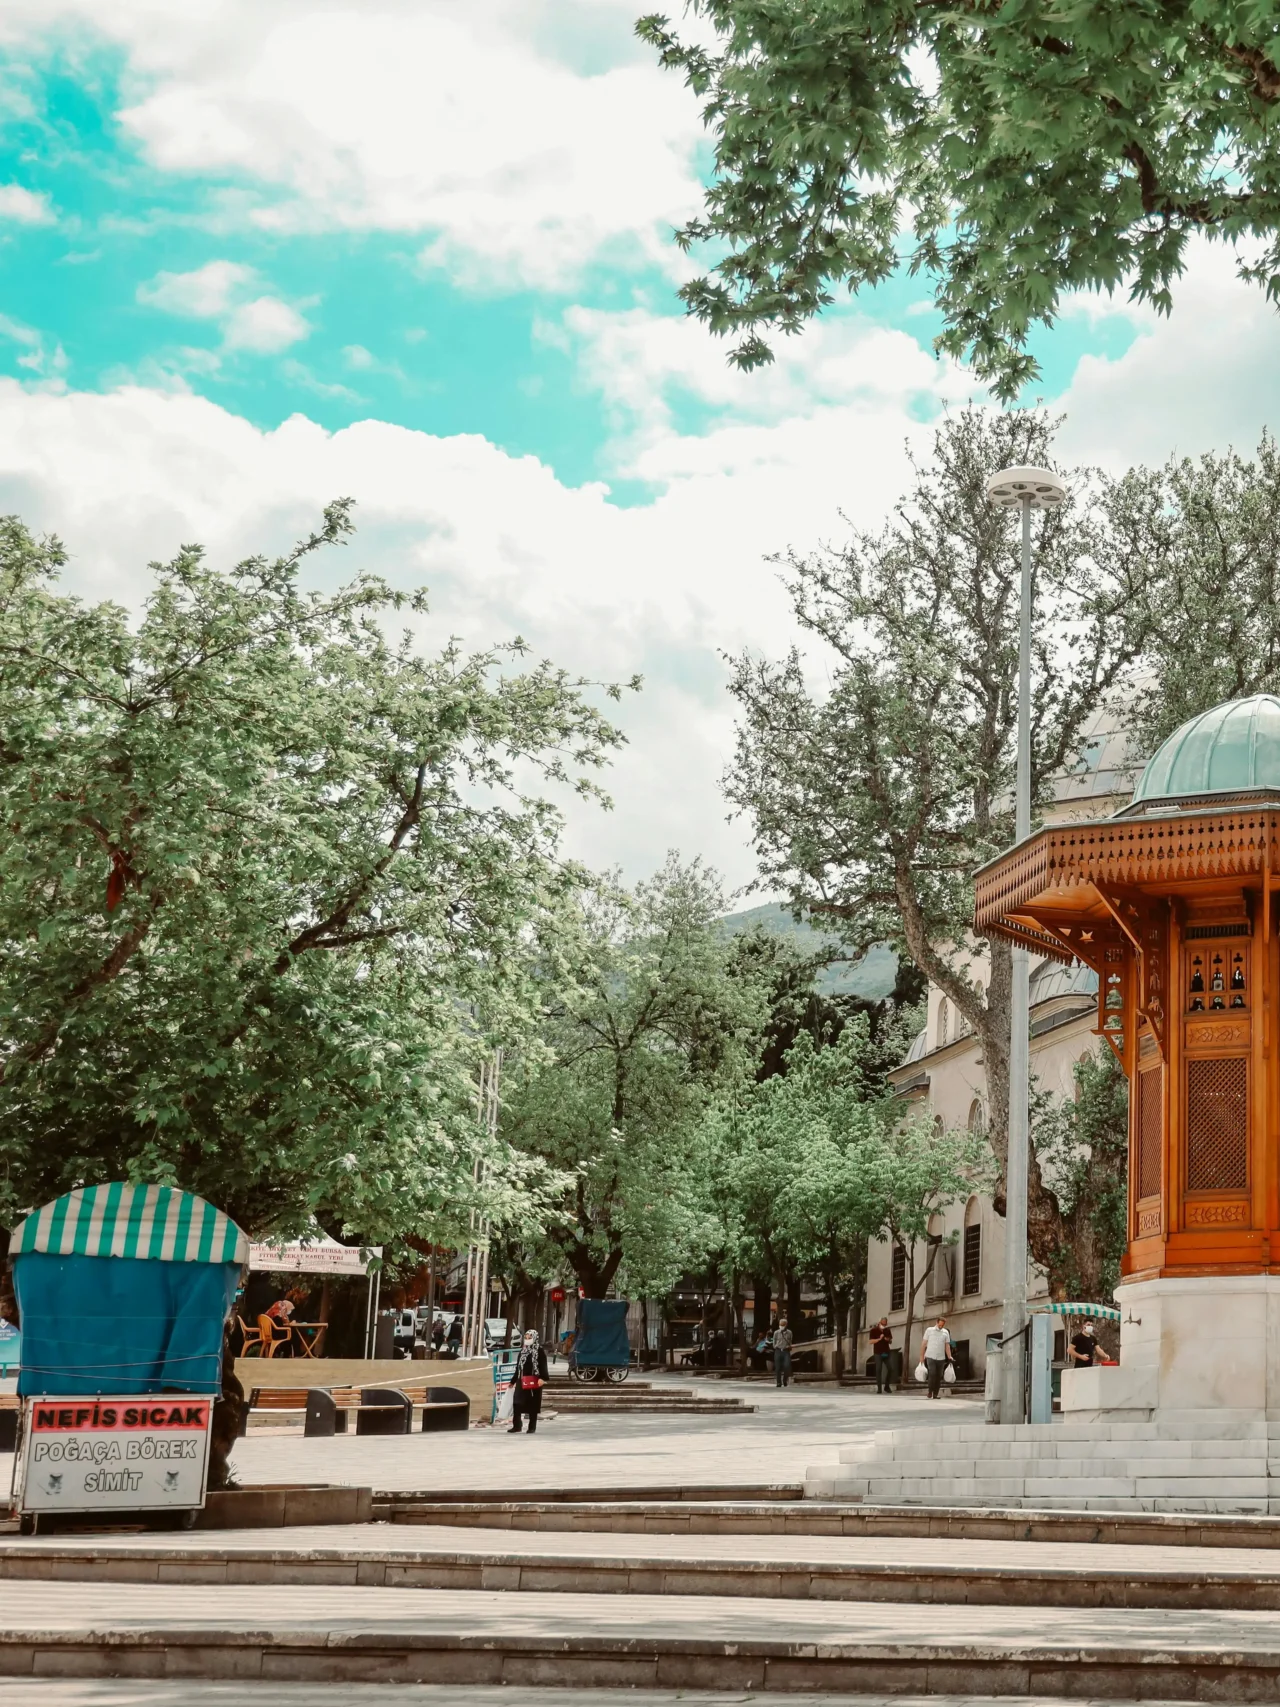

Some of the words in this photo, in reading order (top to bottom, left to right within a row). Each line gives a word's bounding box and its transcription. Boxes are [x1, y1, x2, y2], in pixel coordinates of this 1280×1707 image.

[37, 1405, 117, 1428] NEFİS
[34, 1438, 121, 1465] POĞAÇA
[126, 1437, 198, 1460] BÖREK
[84, 1468, 143, 1492] SİMİT
